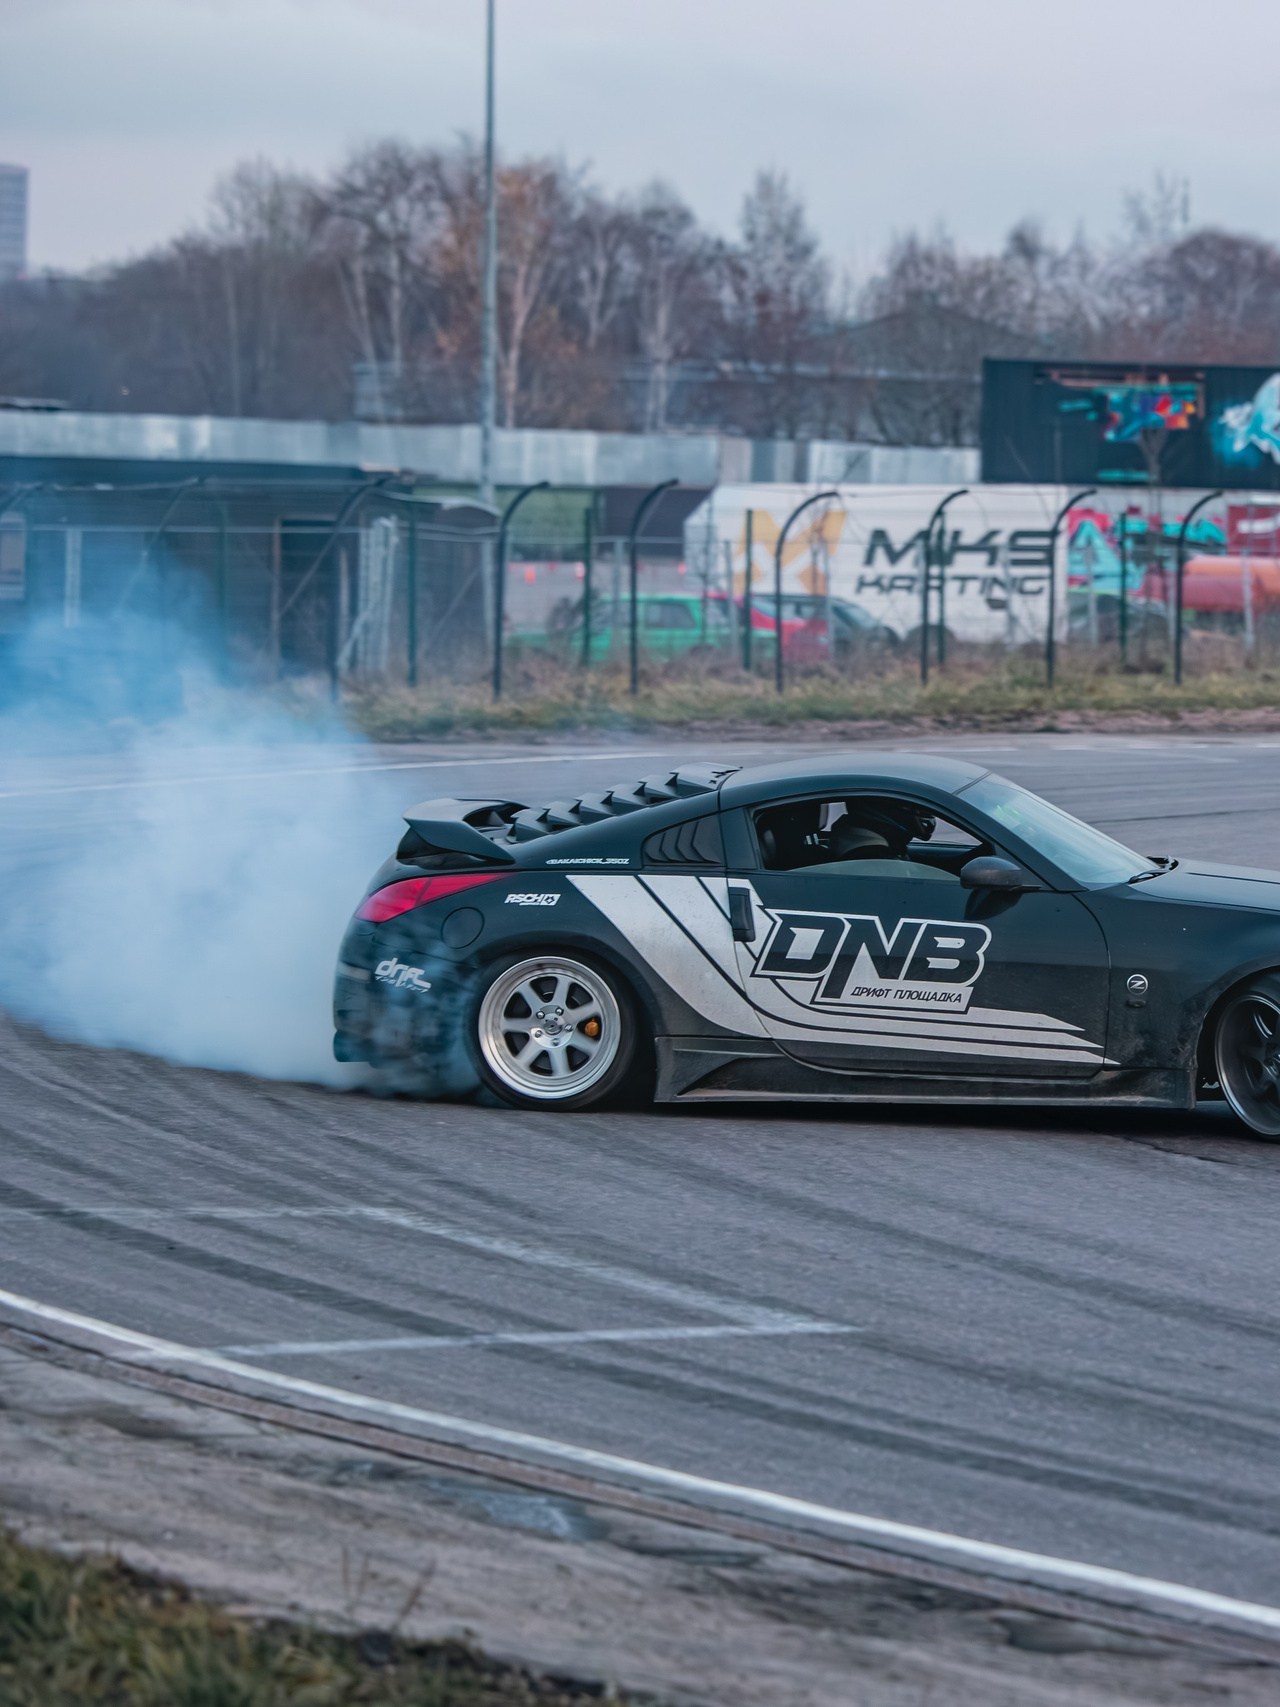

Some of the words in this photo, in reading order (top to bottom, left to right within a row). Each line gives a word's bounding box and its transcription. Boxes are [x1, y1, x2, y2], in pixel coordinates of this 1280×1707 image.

[757, 910, 990, 1000] DNB
[850, 986, 892, 999] ДРИФТ
[893, 989, 963, 1003] ПЛОЩАДКА
